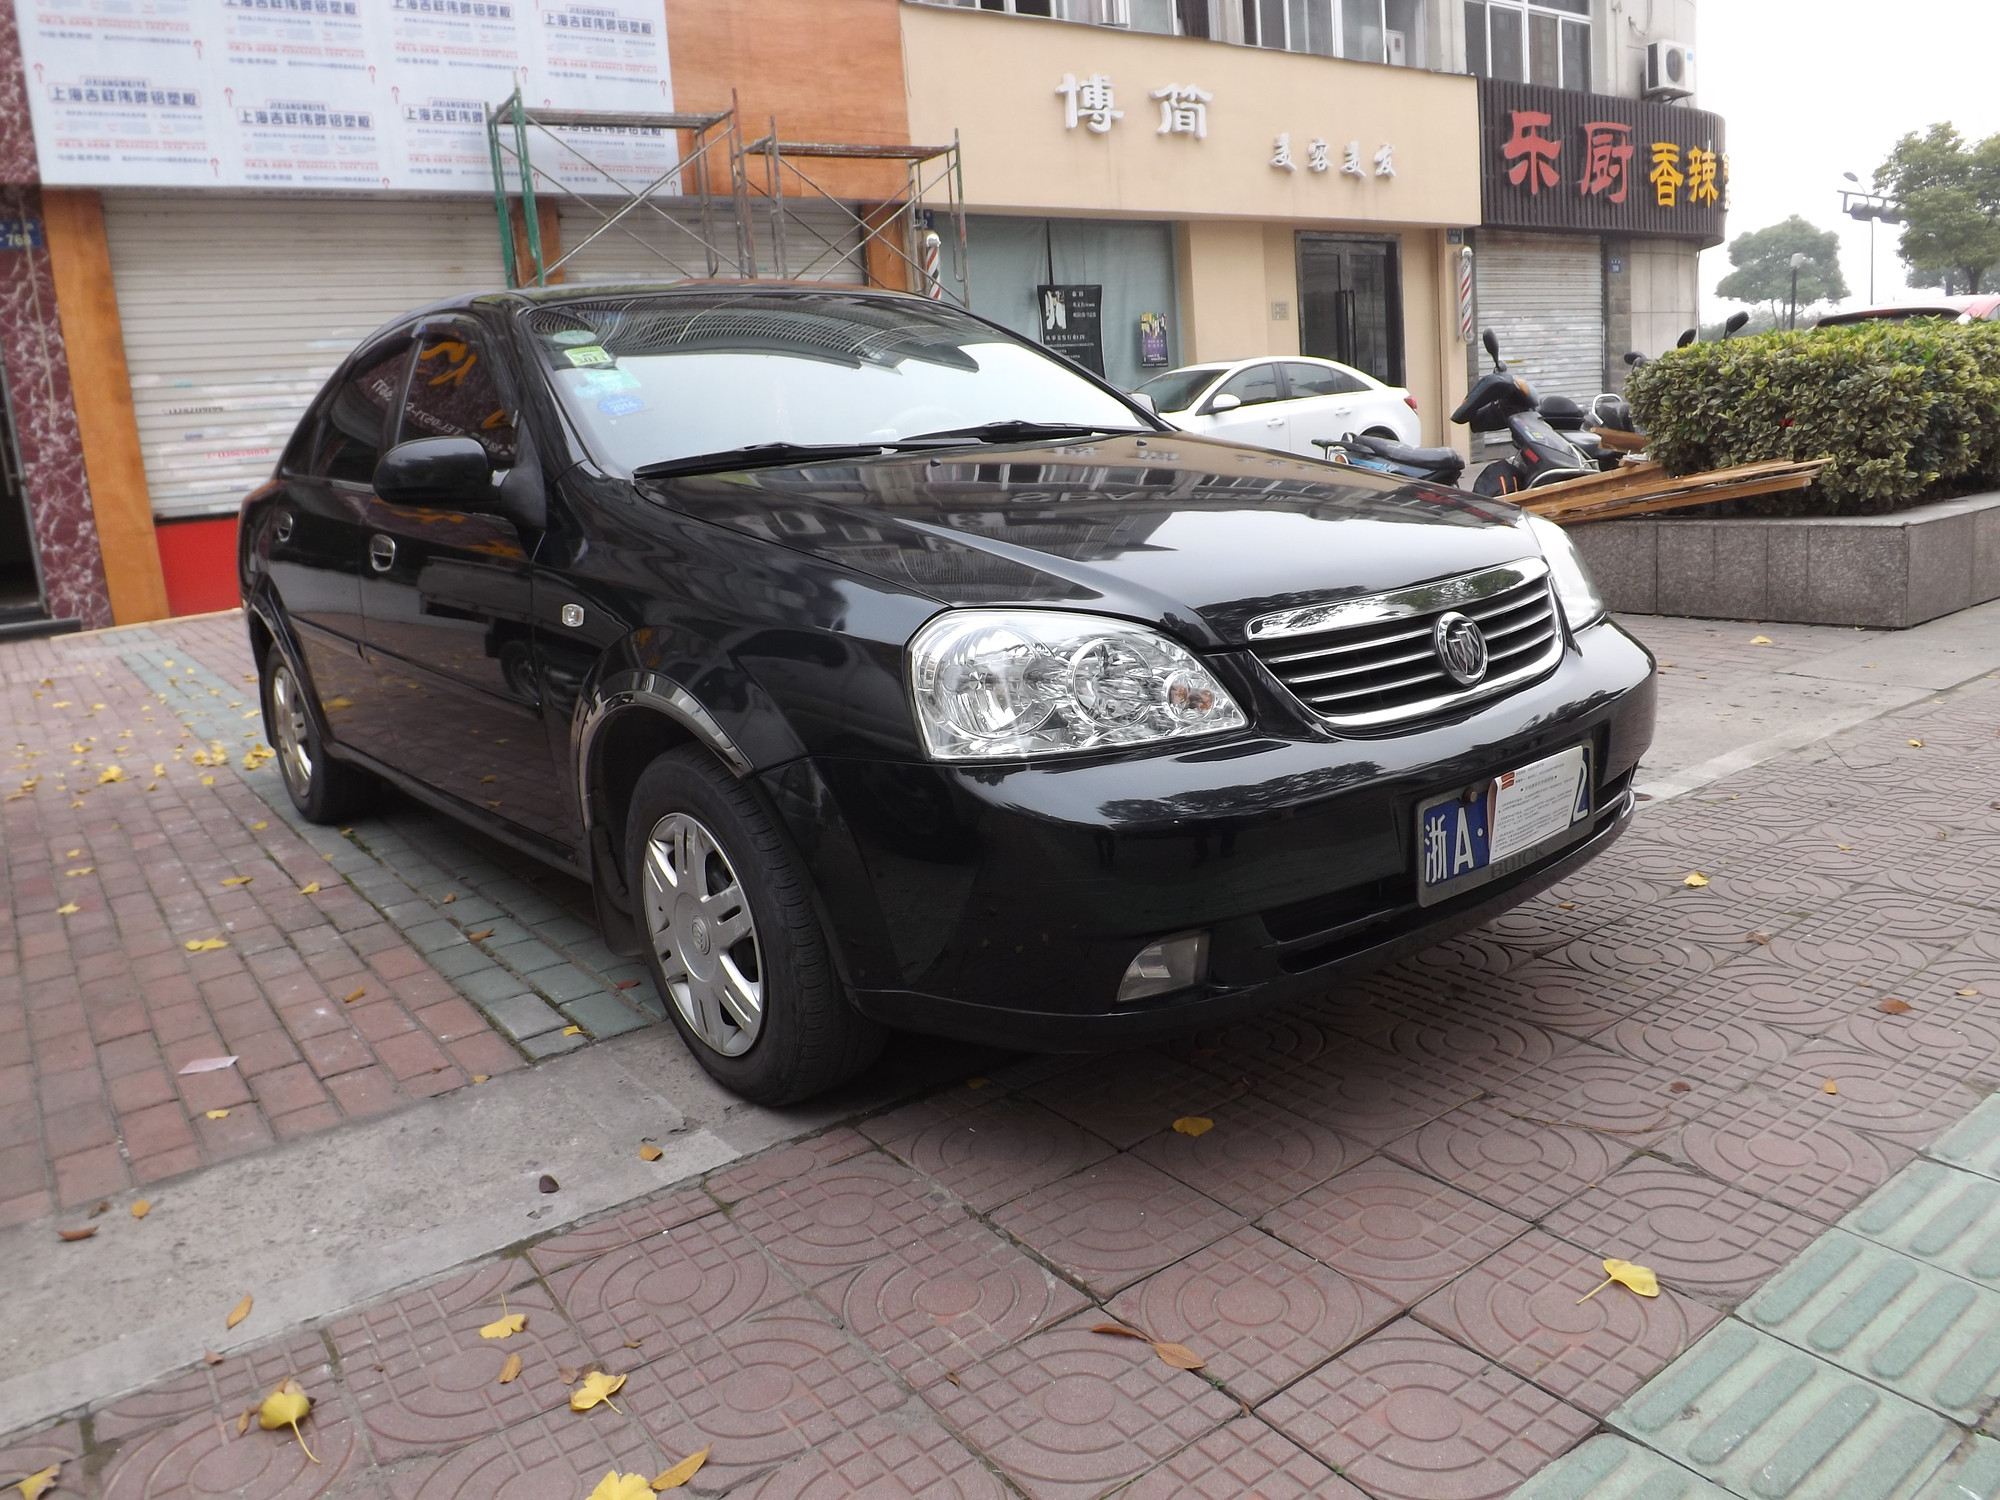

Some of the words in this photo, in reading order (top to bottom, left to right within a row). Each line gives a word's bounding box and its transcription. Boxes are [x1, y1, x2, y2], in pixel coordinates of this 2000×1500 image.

[1055, 72, 1214, 139] 博简
[1503, 109, 1635, 204] 乐厨
[1649, 141, 1720, 208] 香辣
[1572, 760, 1589, 823] 2
